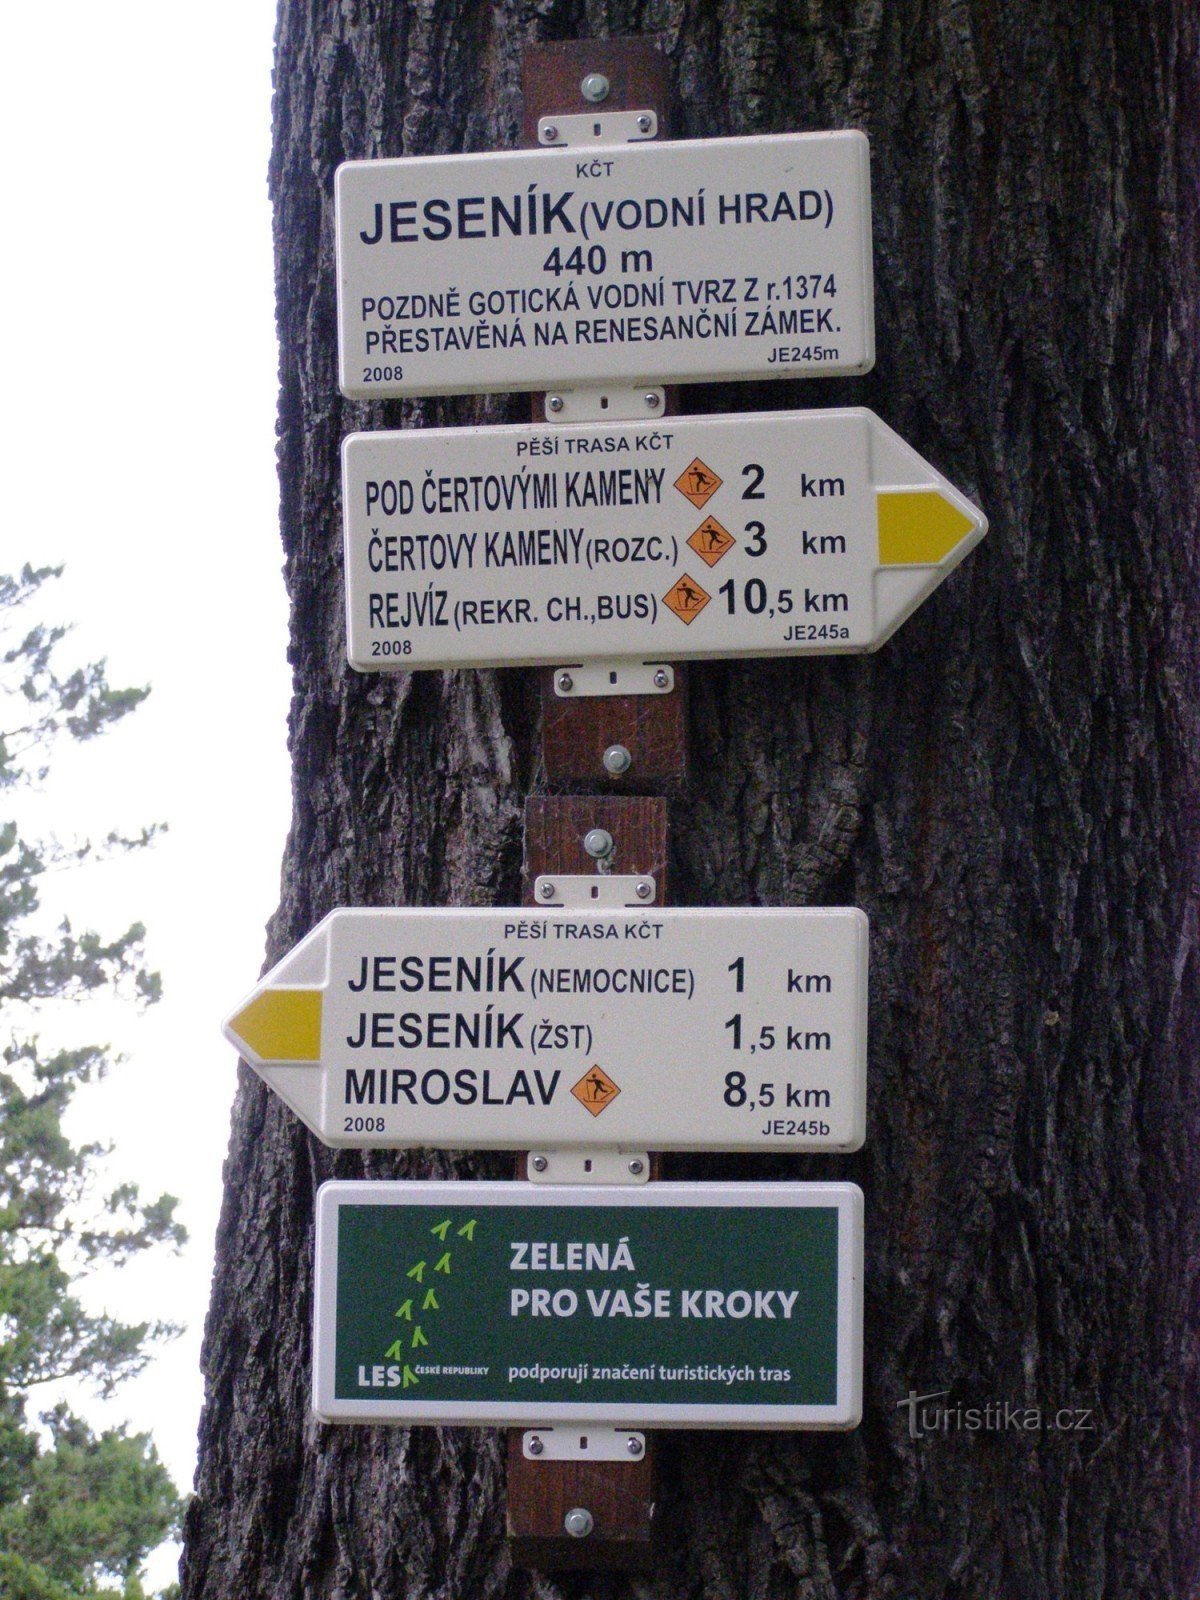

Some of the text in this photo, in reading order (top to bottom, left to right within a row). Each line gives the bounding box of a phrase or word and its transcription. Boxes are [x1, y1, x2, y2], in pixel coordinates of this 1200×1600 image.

[575, 159, 614, 178] KČT
[718, 190, 833, 228] HRAD)
[542, 245, 652, 276] 440 m
[361, 274, 836, 321] POZDNĚ GOTICKÁ VODNÍ TVRZ Z r.1374
[365, 305, 840, 354] PŘESTAVĚNÁ NA RENESANČNÍ ZÁMEK.
[767, 346, 838, 363] JE245m
[362, 366, 403, 382] 2008
[516, 432, 673, 456] PĚŠÍ TRASA KČT
[365, 464, 844, 516] POD ČERTOVÝMI KAMENY 2 km
[367, 521, 845, 572] ČERTOVY KAMENY (ROZC.) 3 km
[369, 582, 448, 628] REJVÍZ
[453, 599, 537, 631] (REKR.
[718, 578, 793, 618] 10,5
[804, 589, 848, 612] km
[371, 640, 412, 656] 2008
[783, 624, 849, 641] JE245a
[504, 921, 663, 939] PĚŠÍ TRASA KČT
[347, 948, 831, 1000] JESENÍK (NEMOCNICE) 1 km
[346, 1004, 830, 1055] JESENÍK (ŽST) 1,5 km
[344, 1069, 830, 1111] MIROSLAV 8,5 km
[343, 1117, 385, 1132] 2008
[761, 1120, 830, 1135] JE245b
[509, 1237, 635, 1270] ZELENÁ
[510, 1283, 799, 1318] PRO VAŠE KROKY
[414, 1365, 440, 1374] ČESKÉ
[441, 1367, 489, 1375] REPUBLIKY
[508, 1363, 791, 1385] podporují značení turistických tras
